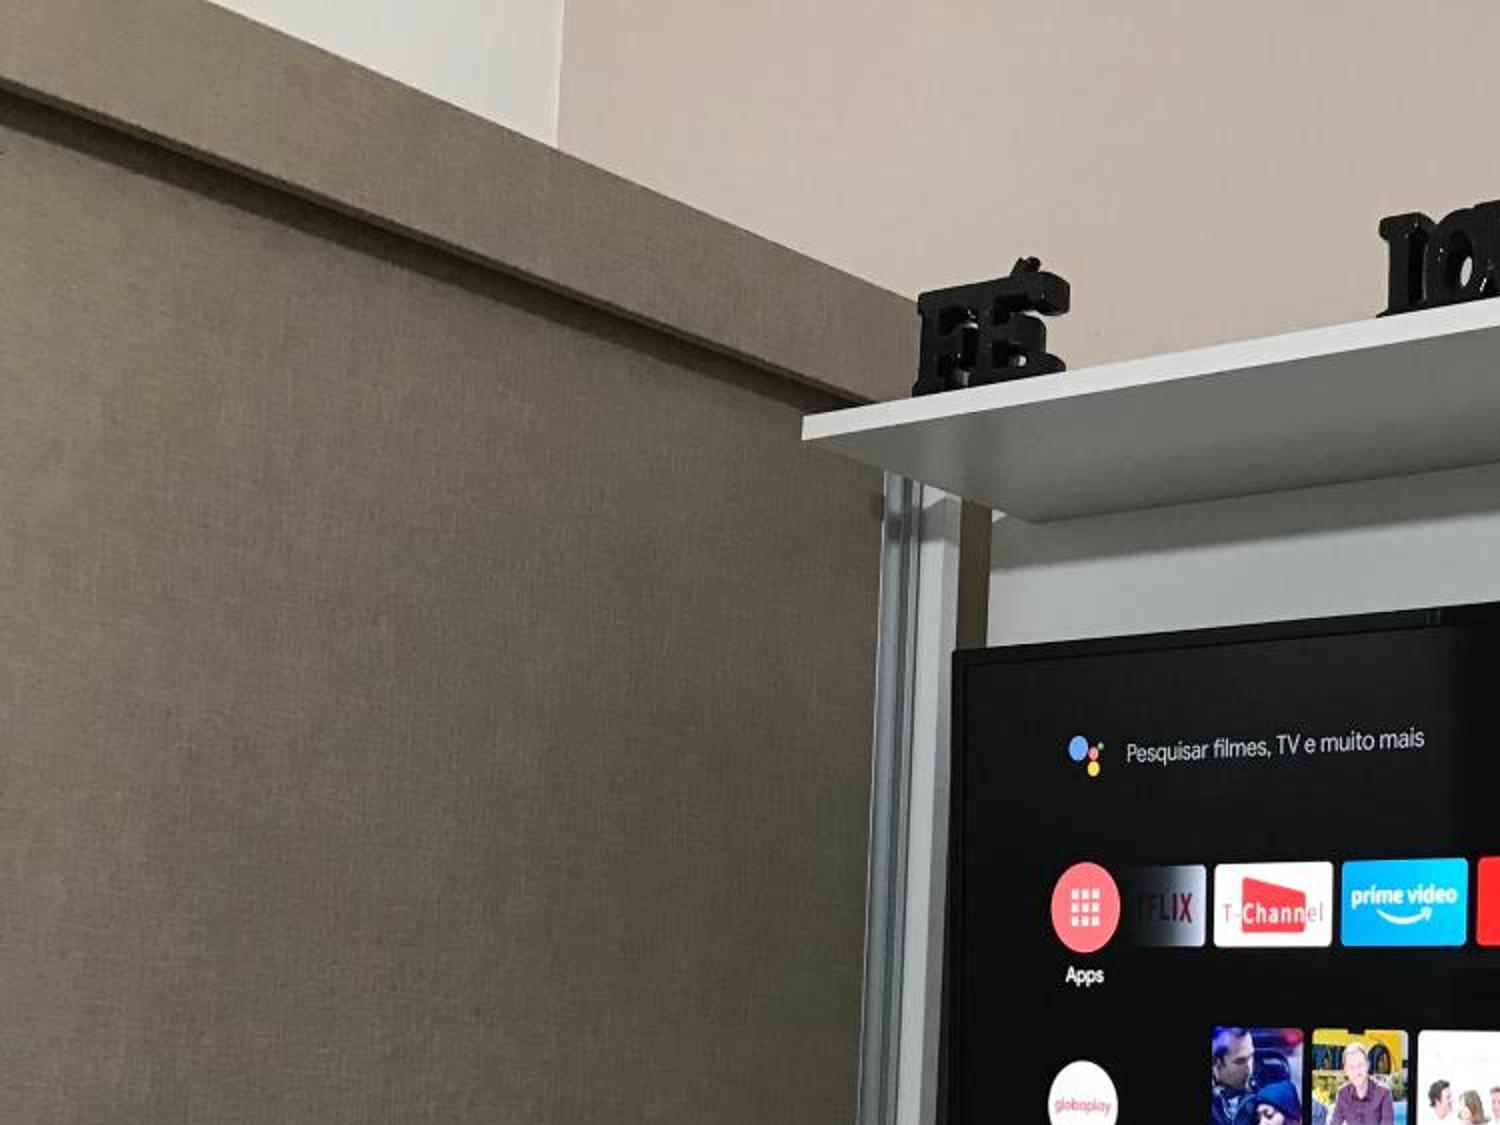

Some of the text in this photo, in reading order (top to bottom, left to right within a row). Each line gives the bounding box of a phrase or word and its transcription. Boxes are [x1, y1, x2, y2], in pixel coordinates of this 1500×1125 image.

[1126, 726, 1425, 767] Pesquisar filmes, TV e muito mais
[1351, 884, 1458, 909] prime video
[1065, 966, 1105, 987] Apps
